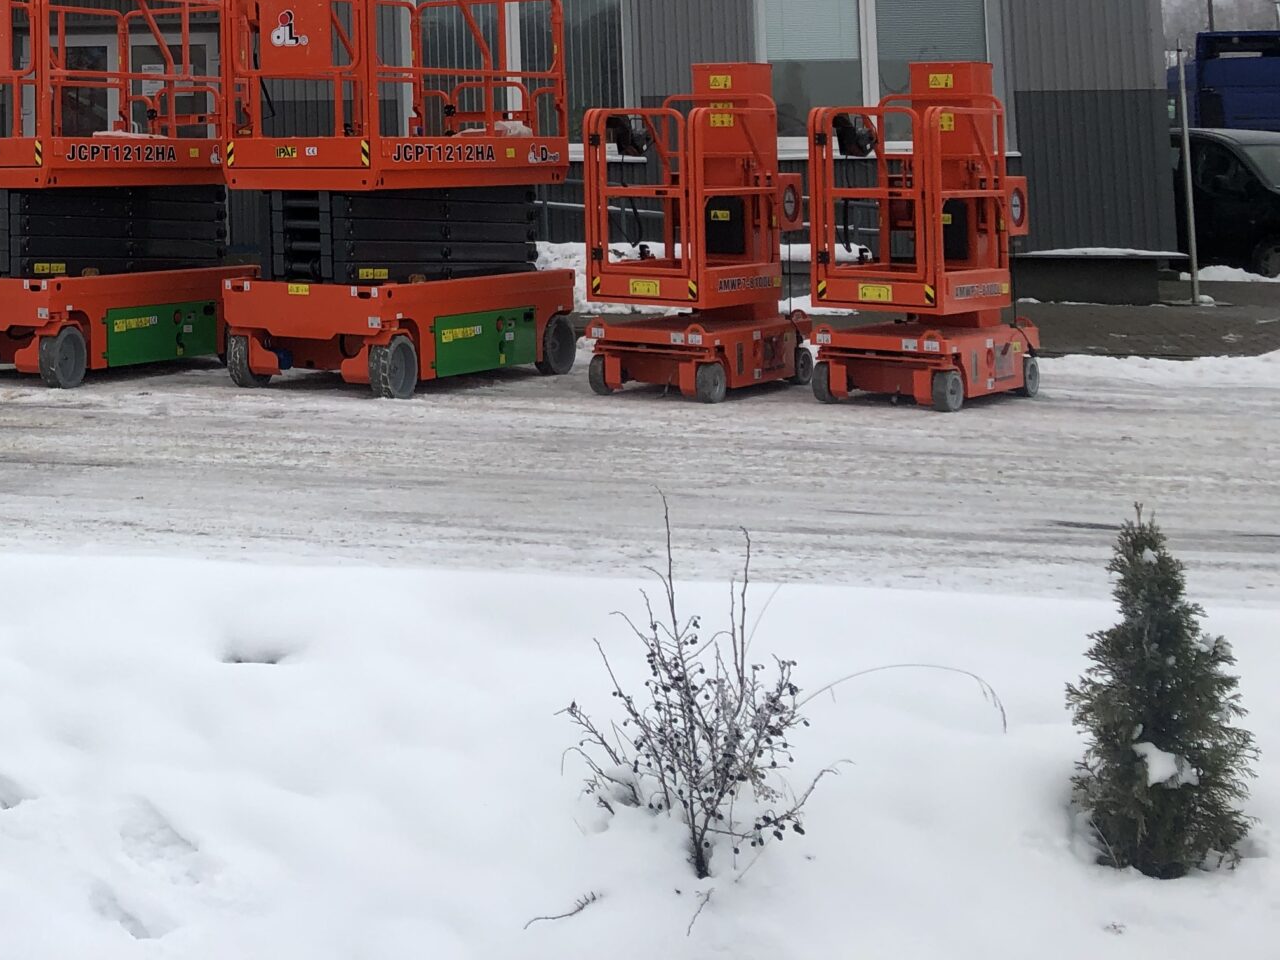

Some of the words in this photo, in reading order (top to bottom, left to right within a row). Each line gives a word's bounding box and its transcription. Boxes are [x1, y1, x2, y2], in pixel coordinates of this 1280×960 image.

[66, 143, 177, 163] JCPT1212HA
[276, 145, 297, 158] IPAF
[392, 143, 496, 162] JCPT1212HA
